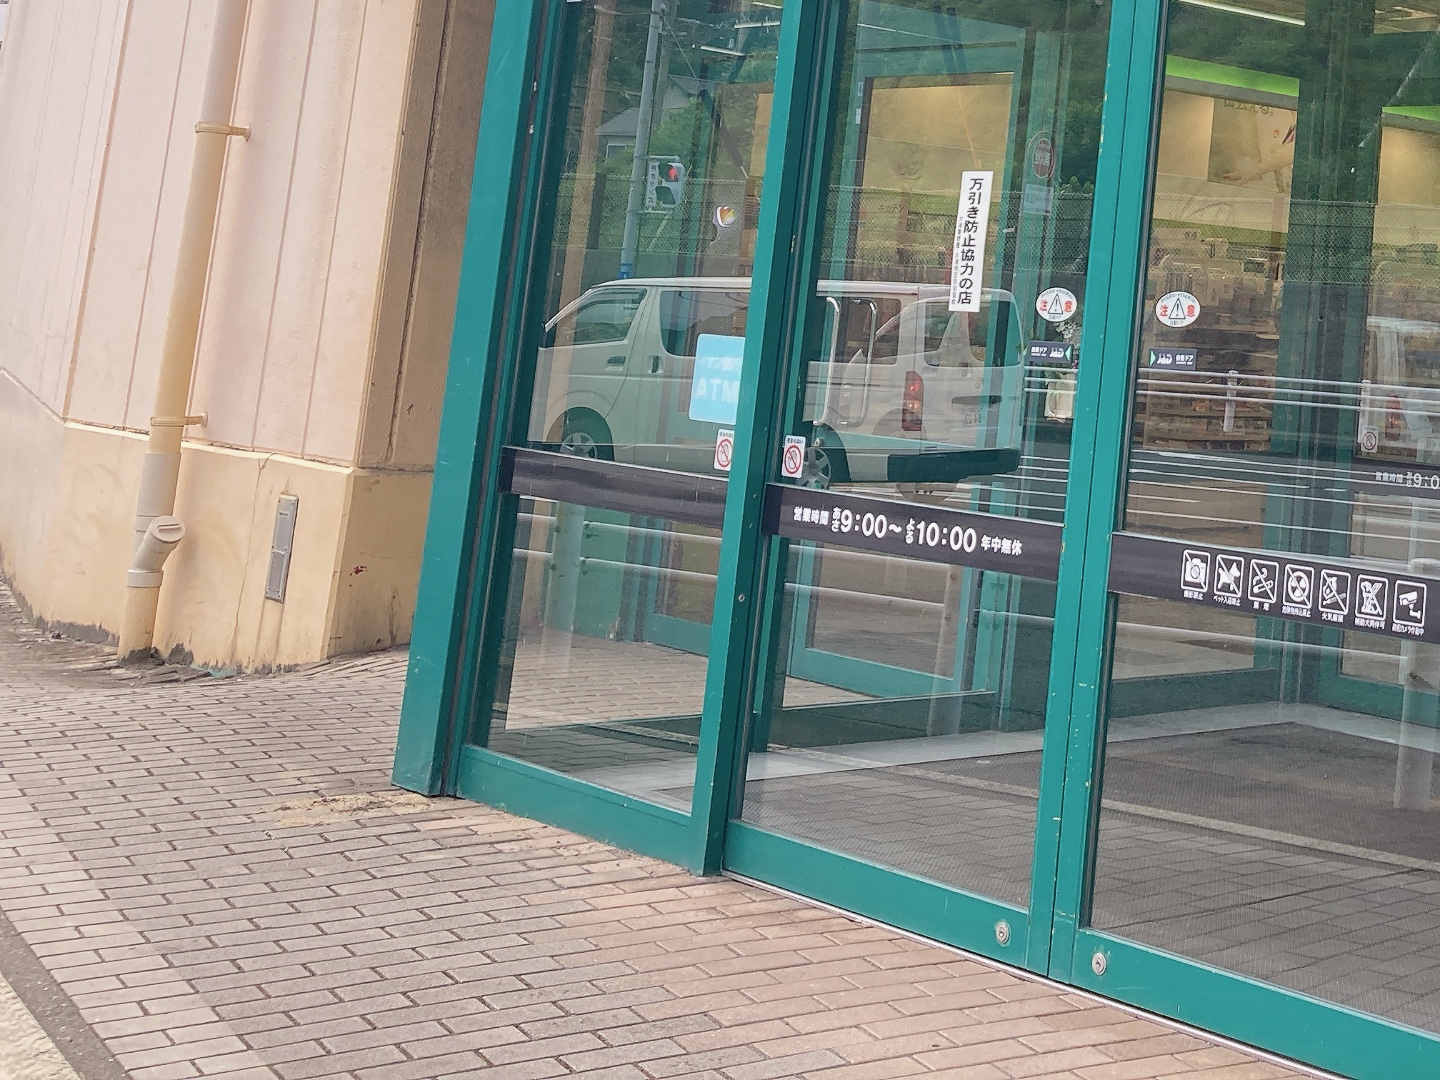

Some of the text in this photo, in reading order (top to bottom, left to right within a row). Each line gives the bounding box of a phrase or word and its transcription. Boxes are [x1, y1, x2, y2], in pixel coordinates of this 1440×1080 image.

[957, 178, 984, 305] 万引き防止協力の店
[695, 377, 740, 403] ATM
[793, 506, 829, 526] 営業時間
[980, 534, 1023, 556] 年中無休
